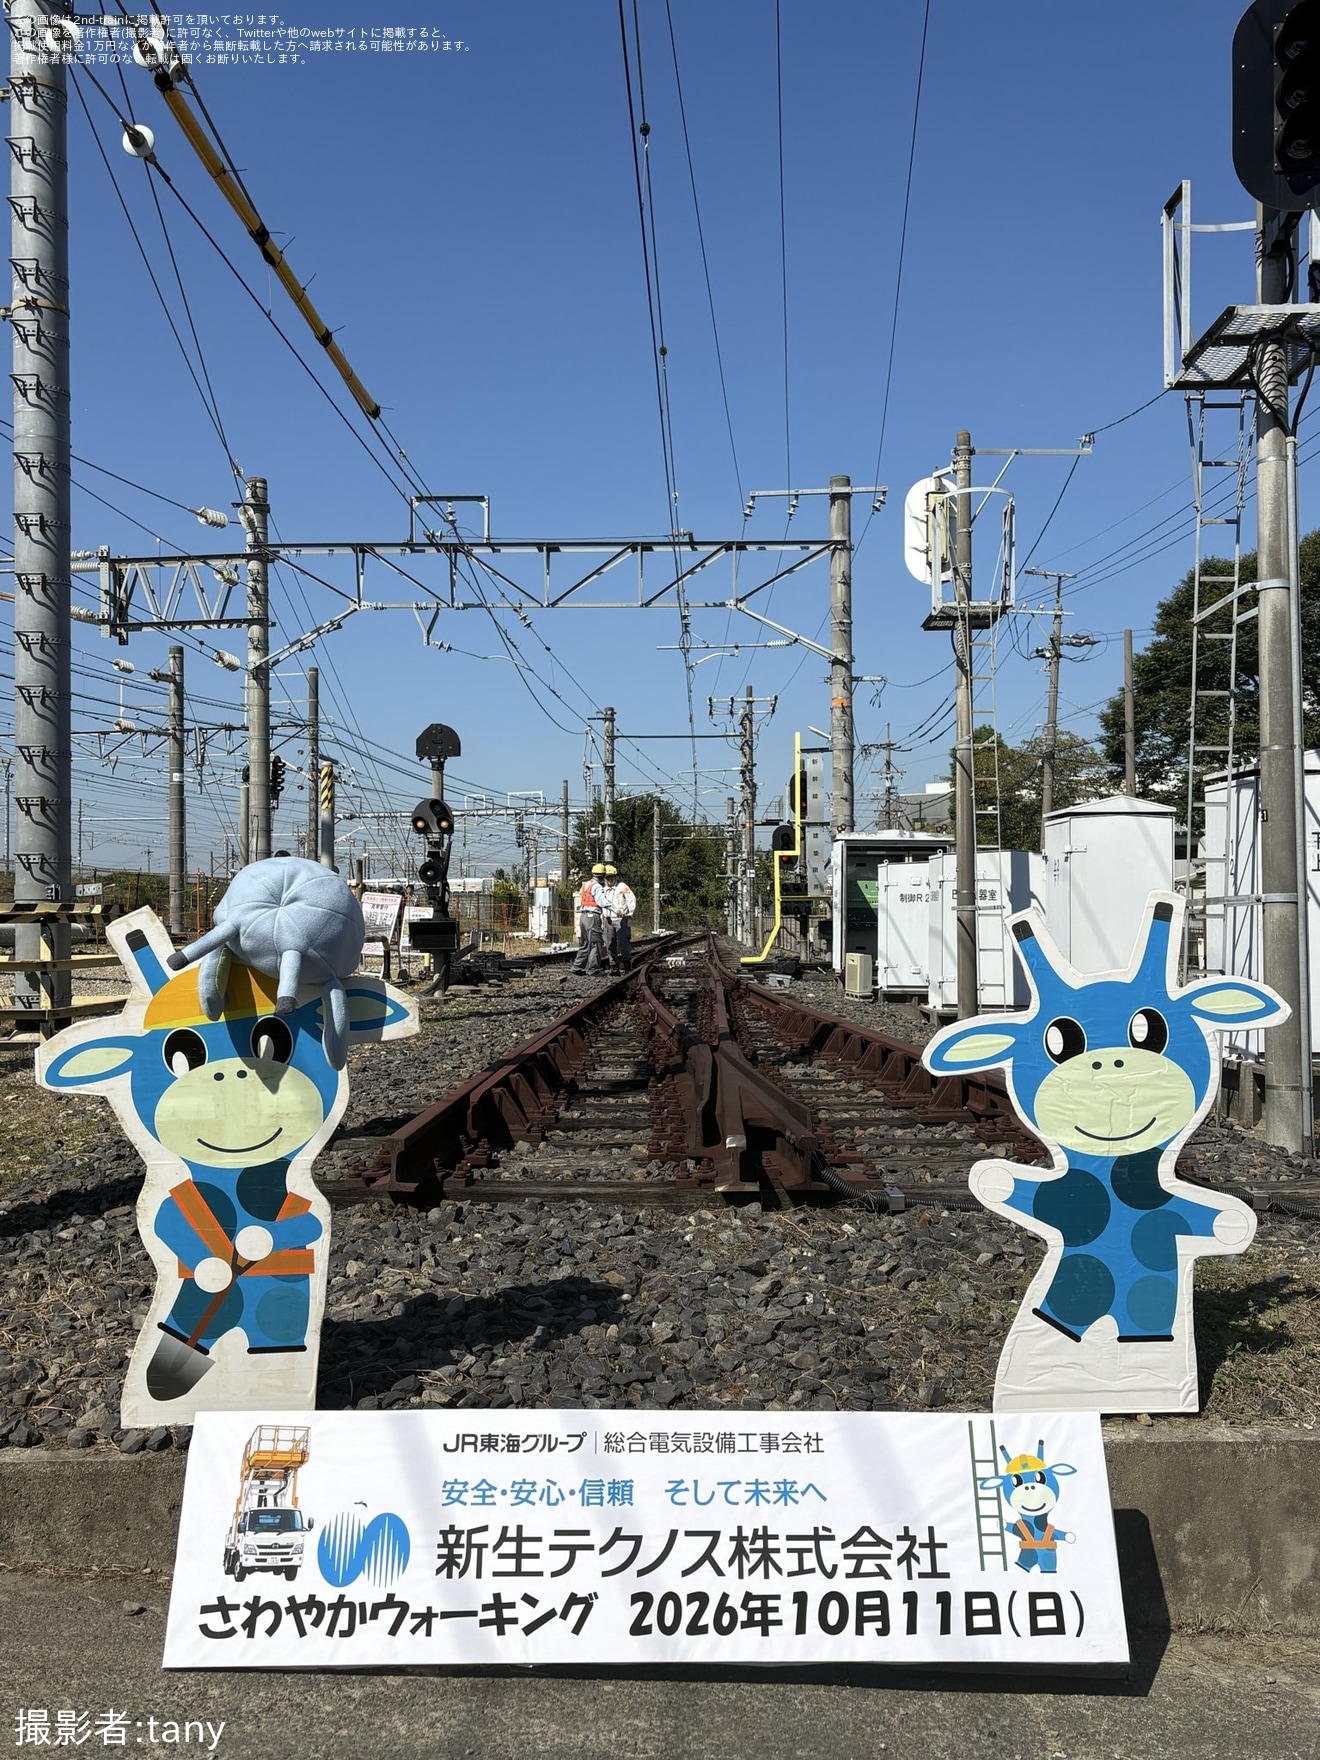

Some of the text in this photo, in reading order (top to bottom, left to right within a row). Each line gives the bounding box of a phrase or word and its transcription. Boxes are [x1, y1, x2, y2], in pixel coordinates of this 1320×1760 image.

[443, 1431, 825, 1454] JR東海グループ 総合電気設備工事会社
[441, 1478, 827, 1507] 安全・安心・信頼 そして未来へ
[435, 1524, 951, 1581] 新生テクノス株式会社
[198, 1589, 1085, 1640] さわやかウォーキング 2026年10月11日(日)
